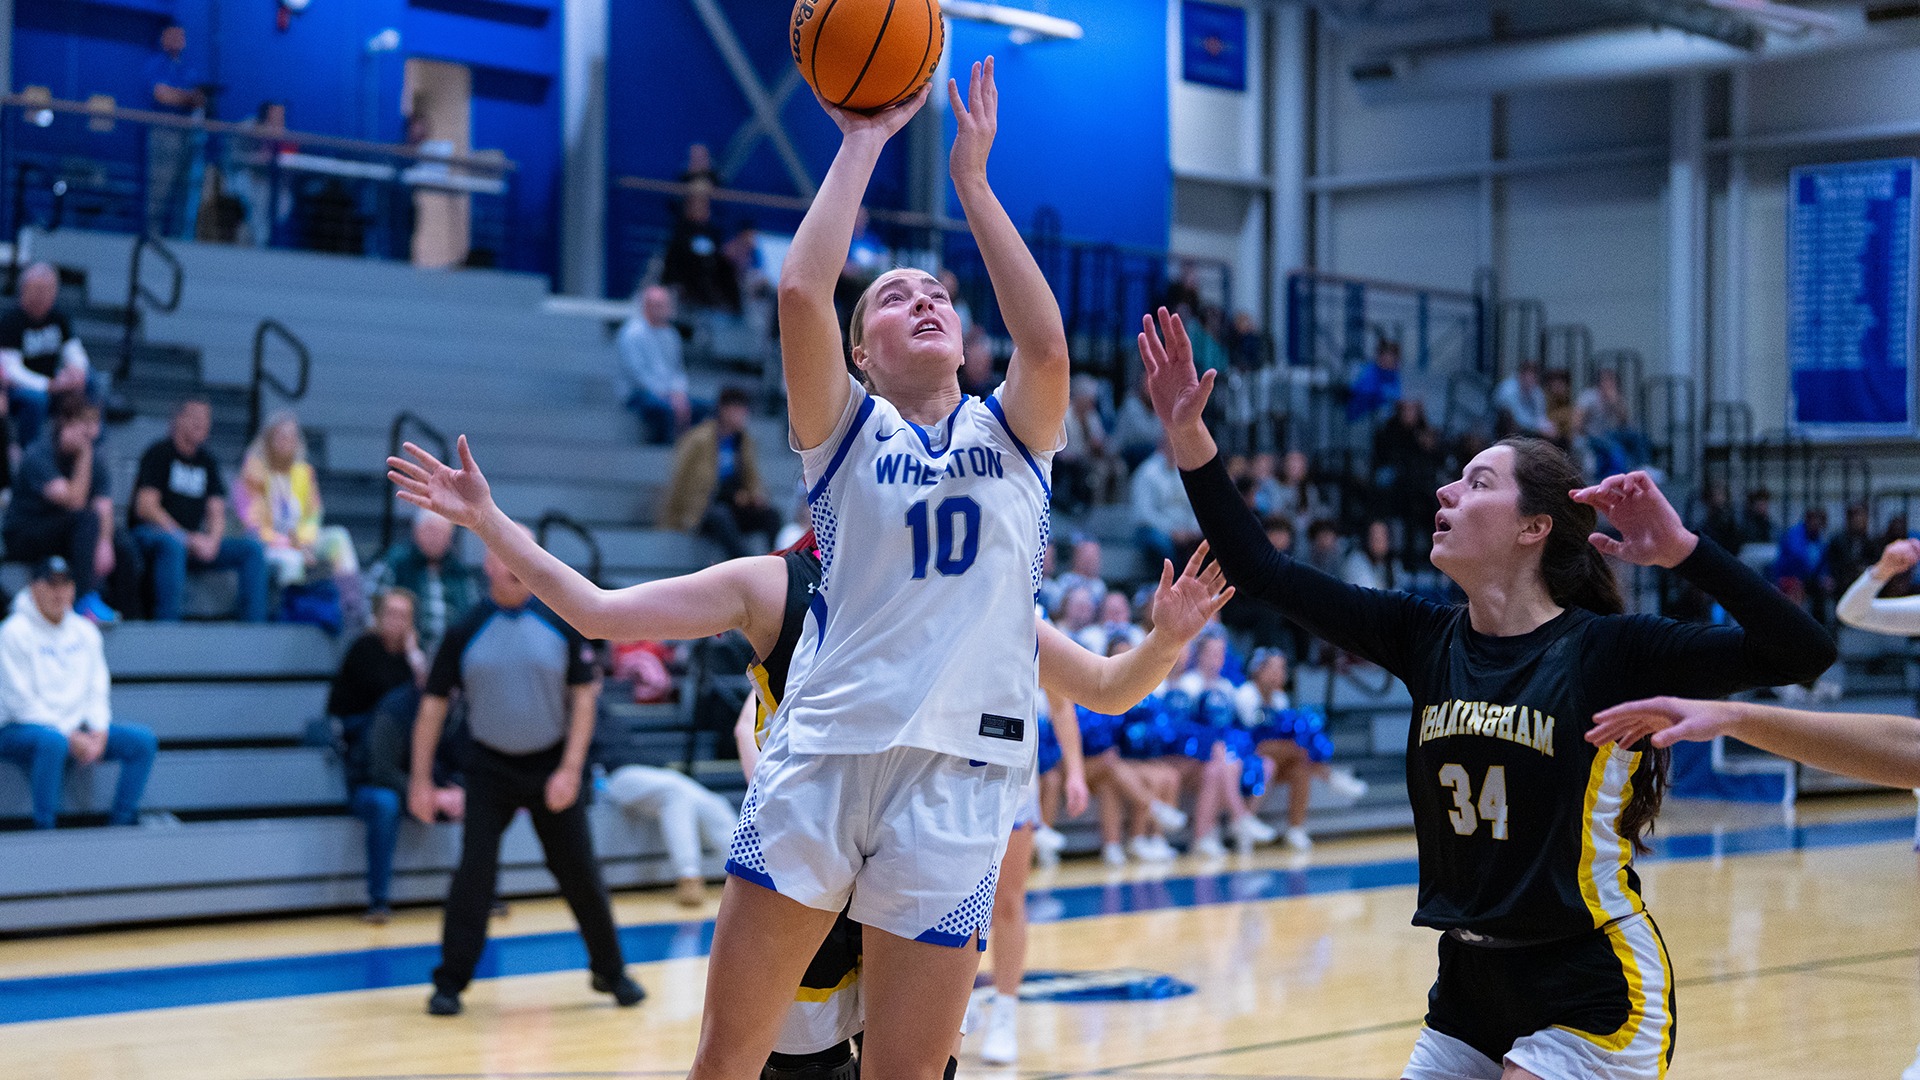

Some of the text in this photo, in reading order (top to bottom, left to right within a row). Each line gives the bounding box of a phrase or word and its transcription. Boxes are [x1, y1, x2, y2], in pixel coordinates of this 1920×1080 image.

[904, 494, 983, 581] 10
[1010, 724, 1016, 734] L
[1438, 762, 1509, 841] 34
